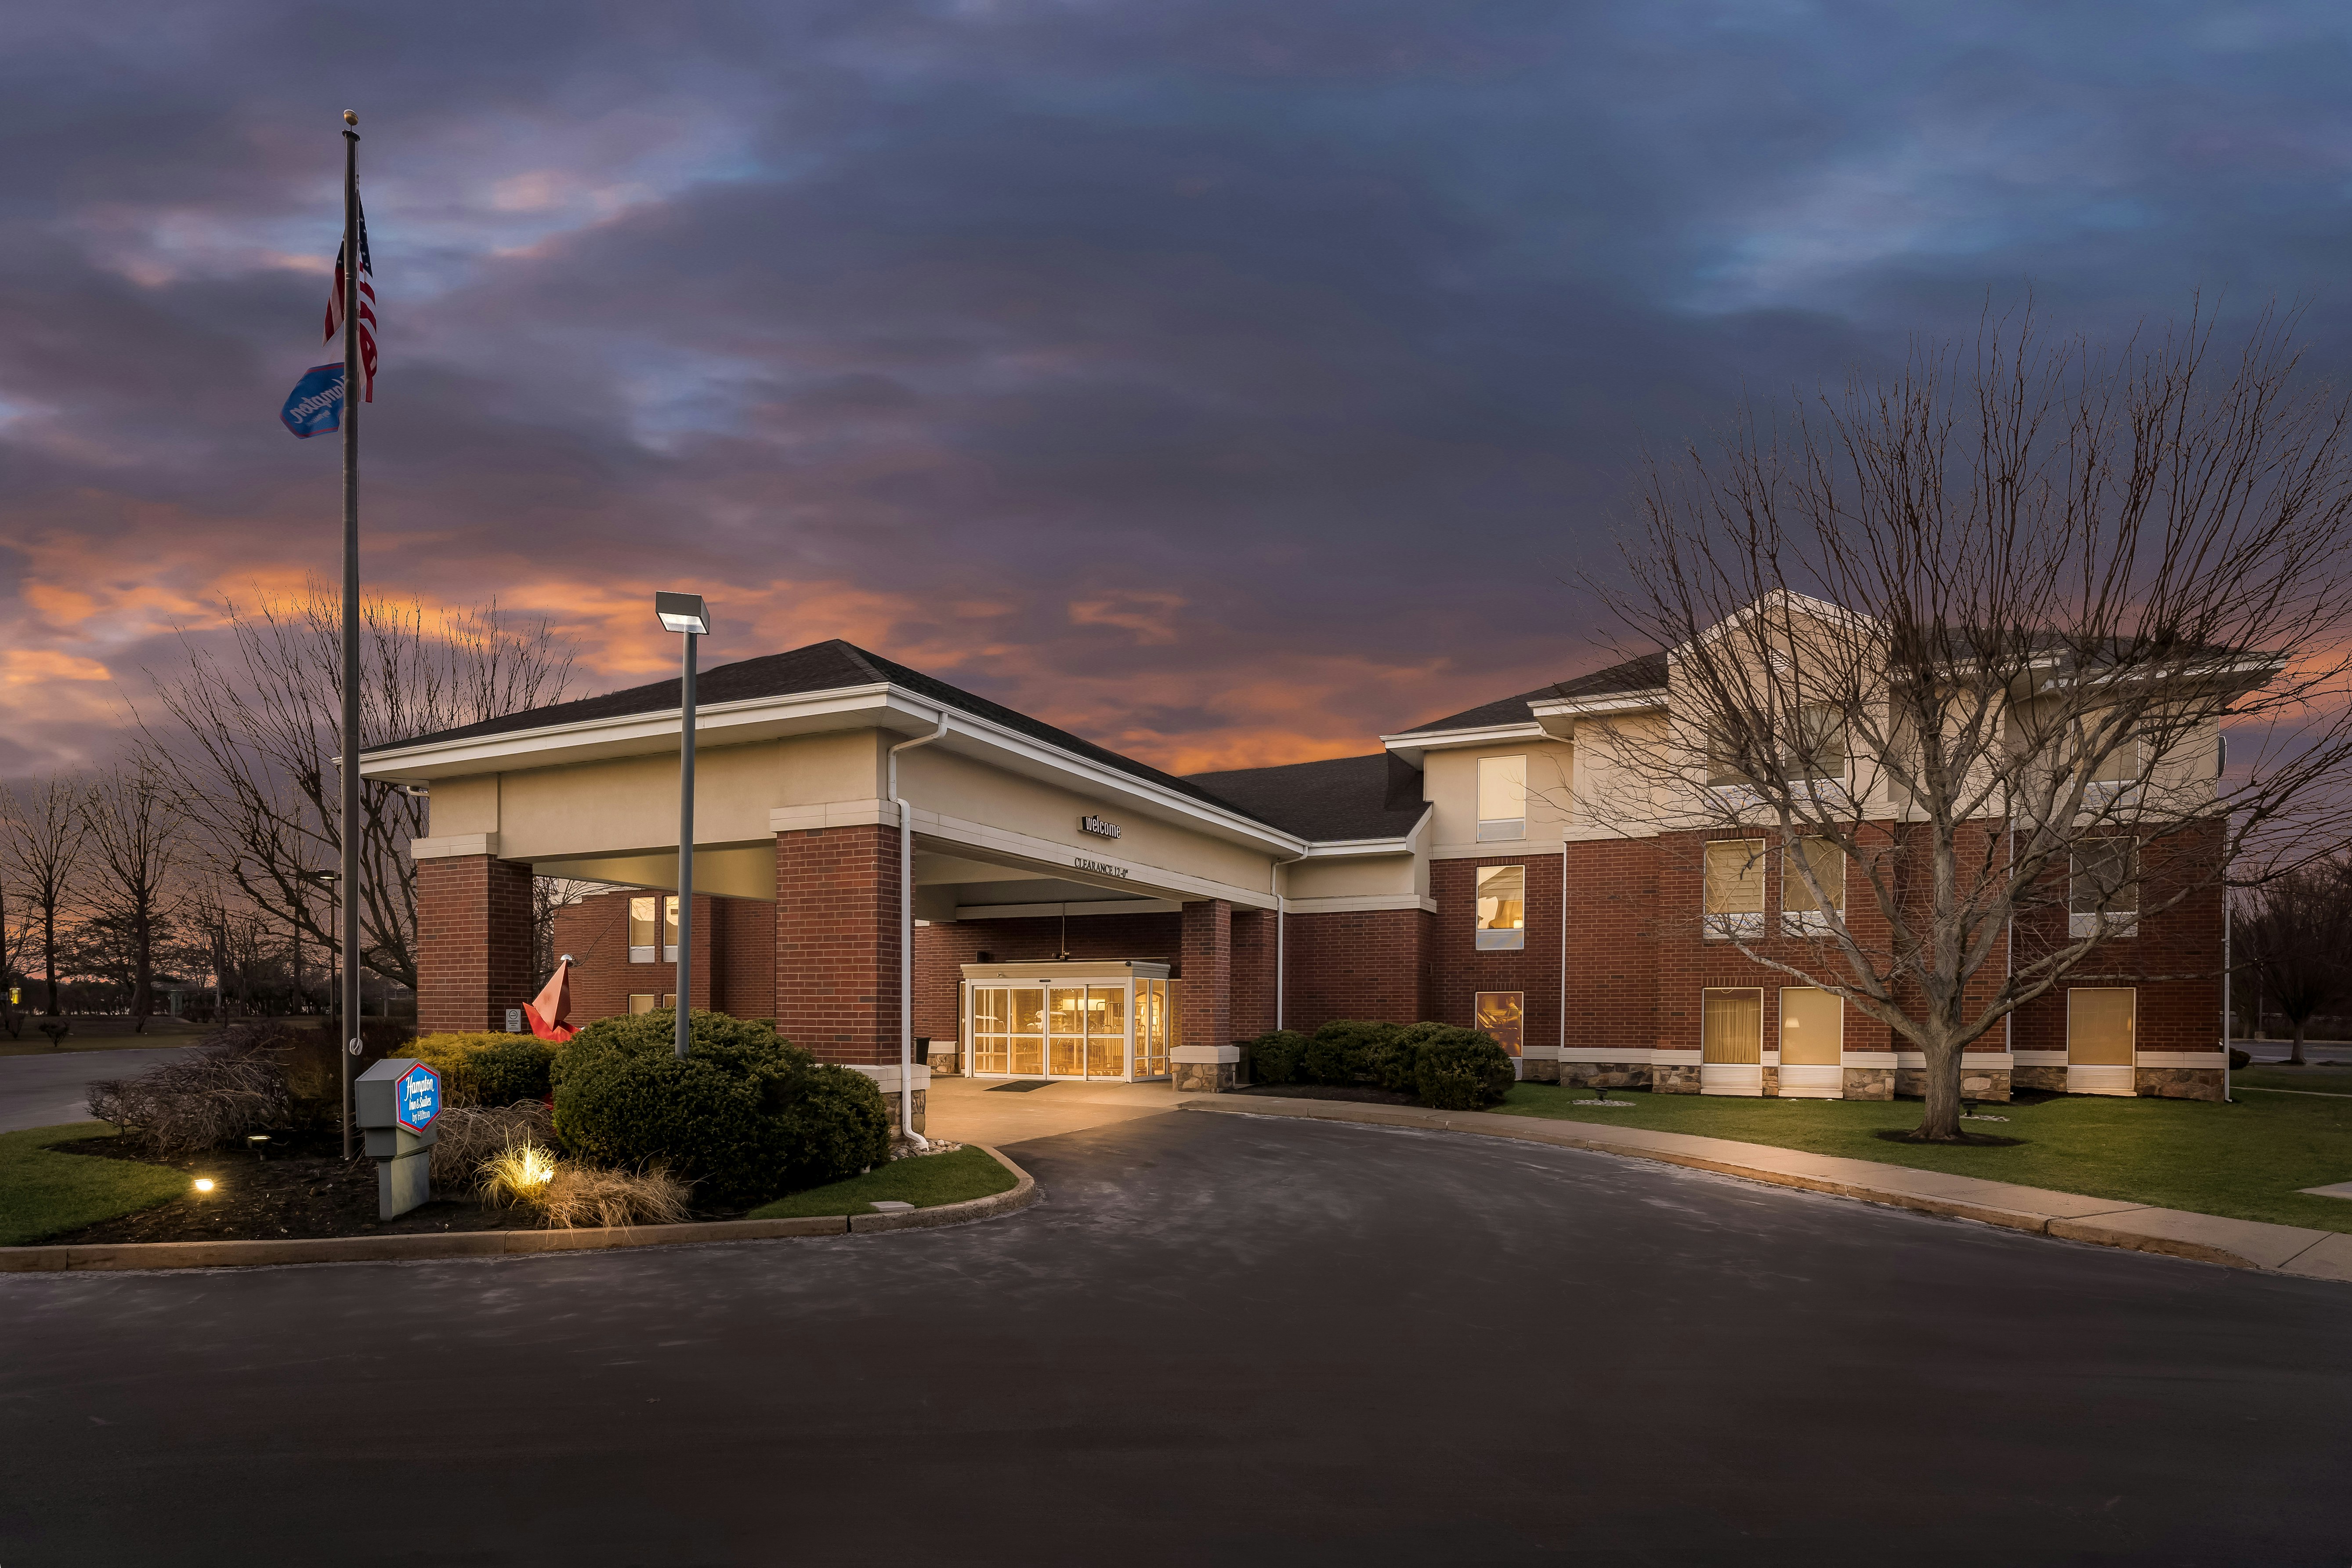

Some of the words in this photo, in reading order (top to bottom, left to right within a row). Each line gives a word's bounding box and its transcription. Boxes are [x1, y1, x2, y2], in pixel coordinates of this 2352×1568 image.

[1086, 815, 1121, 838] welcome
[1075, 858, 1113, 875] CLEARANCE
[404, 1075, 434, 1101] Hampton
[412, 1112, 417, 1124] by
[417, 1110, 430, 1121] Hilton
